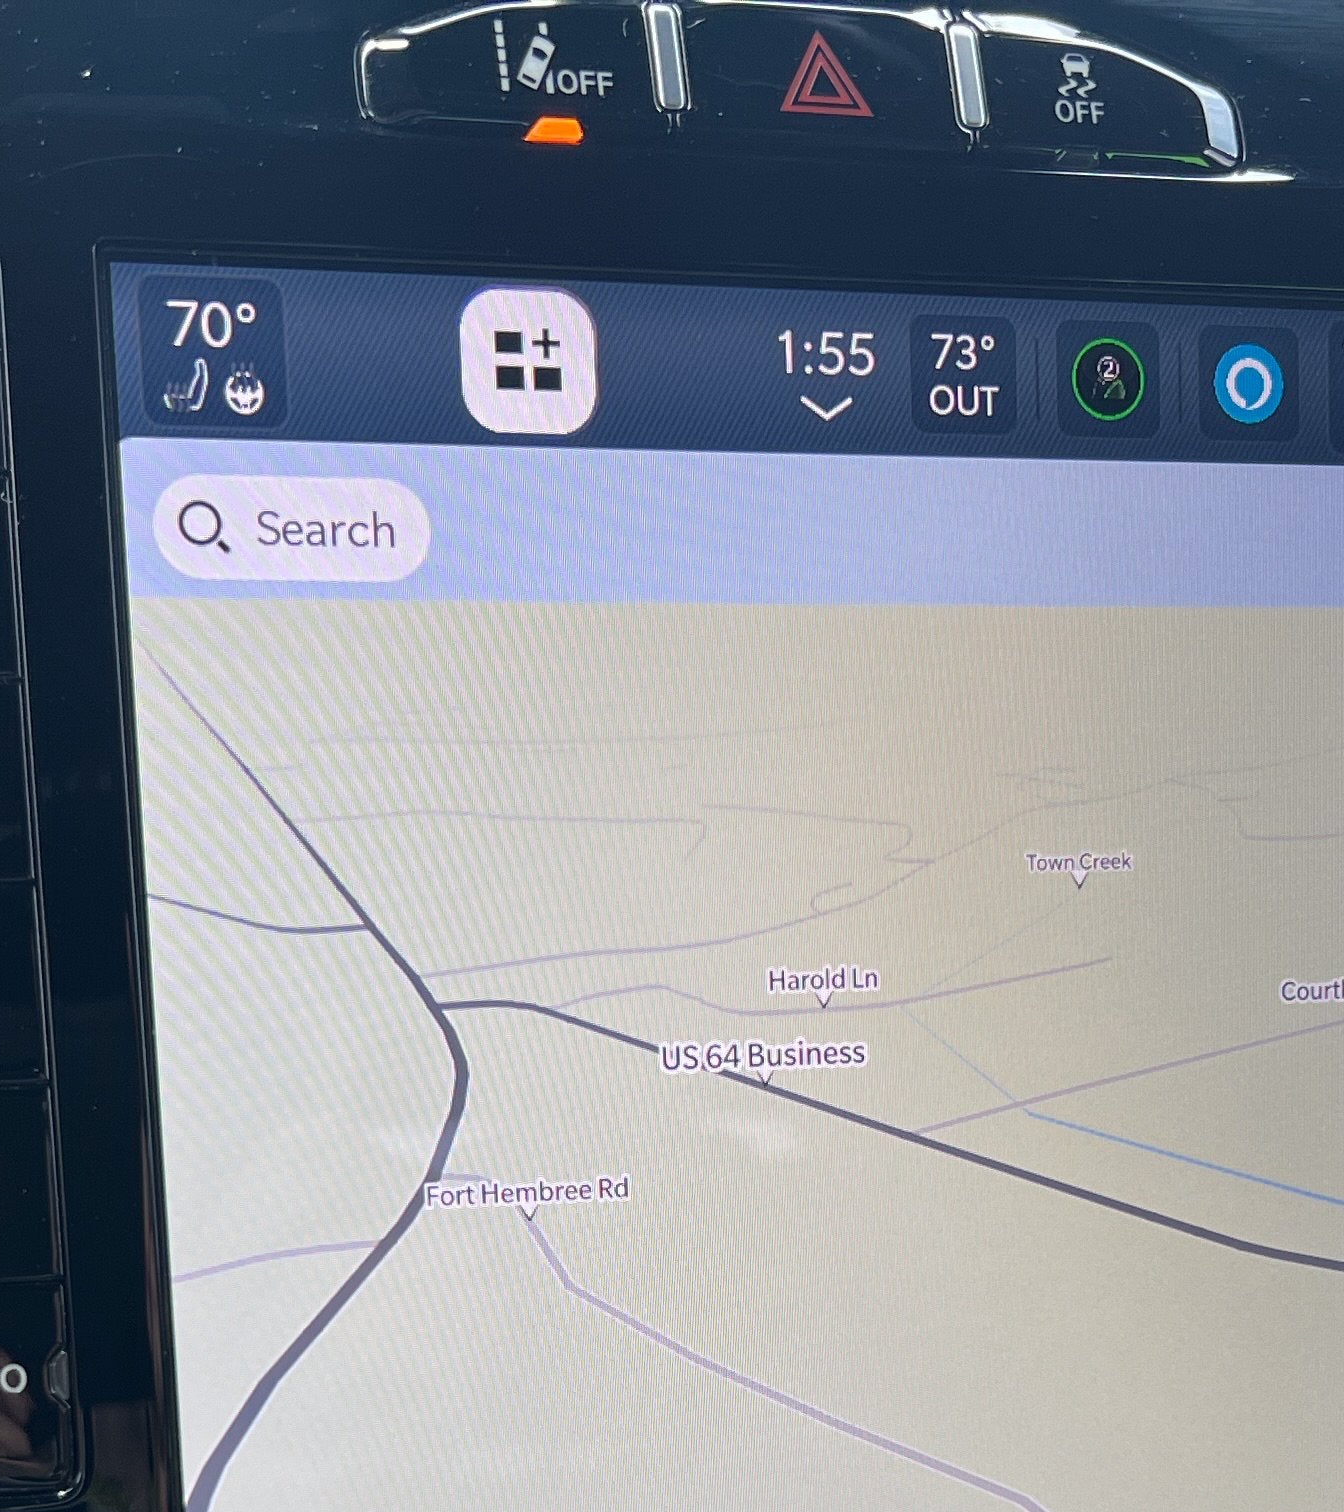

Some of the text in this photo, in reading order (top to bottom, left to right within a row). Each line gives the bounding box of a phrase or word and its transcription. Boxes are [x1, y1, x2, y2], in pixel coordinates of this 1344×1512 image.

[558, 70, 613, 96] OFF
[1054, 99, 1104, 124] OFF
[165, 300, 256, 348] 70°
[777, 330, 876, 376] 1:55
[930, 333, 995, 370] 73°
[929, 386, 999, 416] OUT
[256, 510, 396, 548] Search
[1025, 851, 1132, 872] Town Creek
[768, 967, 879, 992] Harold Ln
[661, 1039, 866, 1071] US 64 Business
[425, 1176, 630, 1207] Fort Hembree Rd
